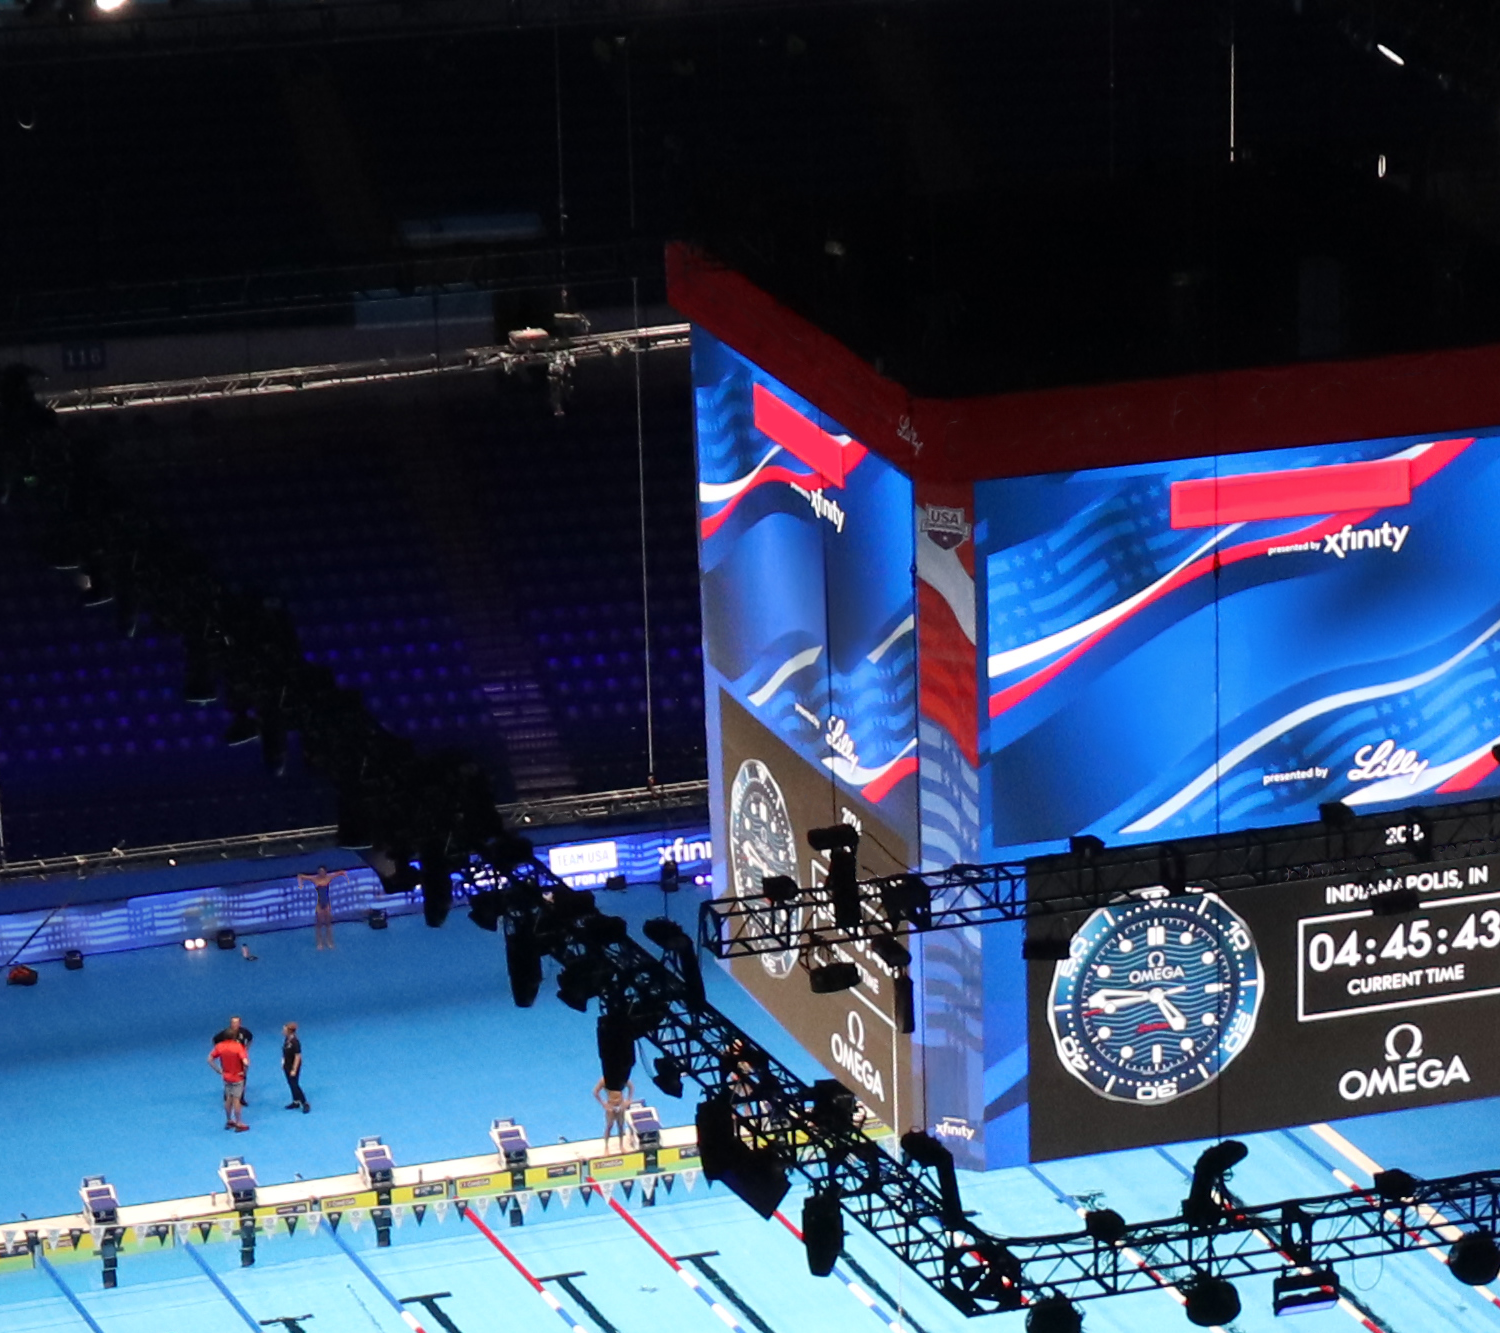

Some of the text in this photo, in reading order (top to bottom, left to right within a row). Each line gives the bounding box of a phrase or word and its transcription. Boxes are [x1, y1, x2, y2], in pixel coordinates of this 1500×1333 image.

[66, 348, 101, 366] 116
[811, 487, 844, 534] xfinity
[931, 511, 960, 524] USA
[1267, 521, 1410, 558] presented by xfinity
[825, 715, 859, 768] Lilly
[1263, 739, 1429, 786] presented by Lilly
[557, 850, 609, 867] TEAM USA
[657, 836, 712, 865] xfini
[1468, 865, 1488, 885] IN
[1229, 920, 1250, 951] 10
[1129, 965, 1185, 984] OMEGA
[1347, 963, 1465, 996] CURRENT TIME
[1225, 1013, 1251, 1053] 20
[831, 1032, 886, 1103] OMEGA
[1061, 1036, 1088, 1071] 40
[1136, 1083, 1179, 1100] 30
[1338, 1055, 1471, 1101] OMEGA
[935, 1121, 975, 1143] xfinity
